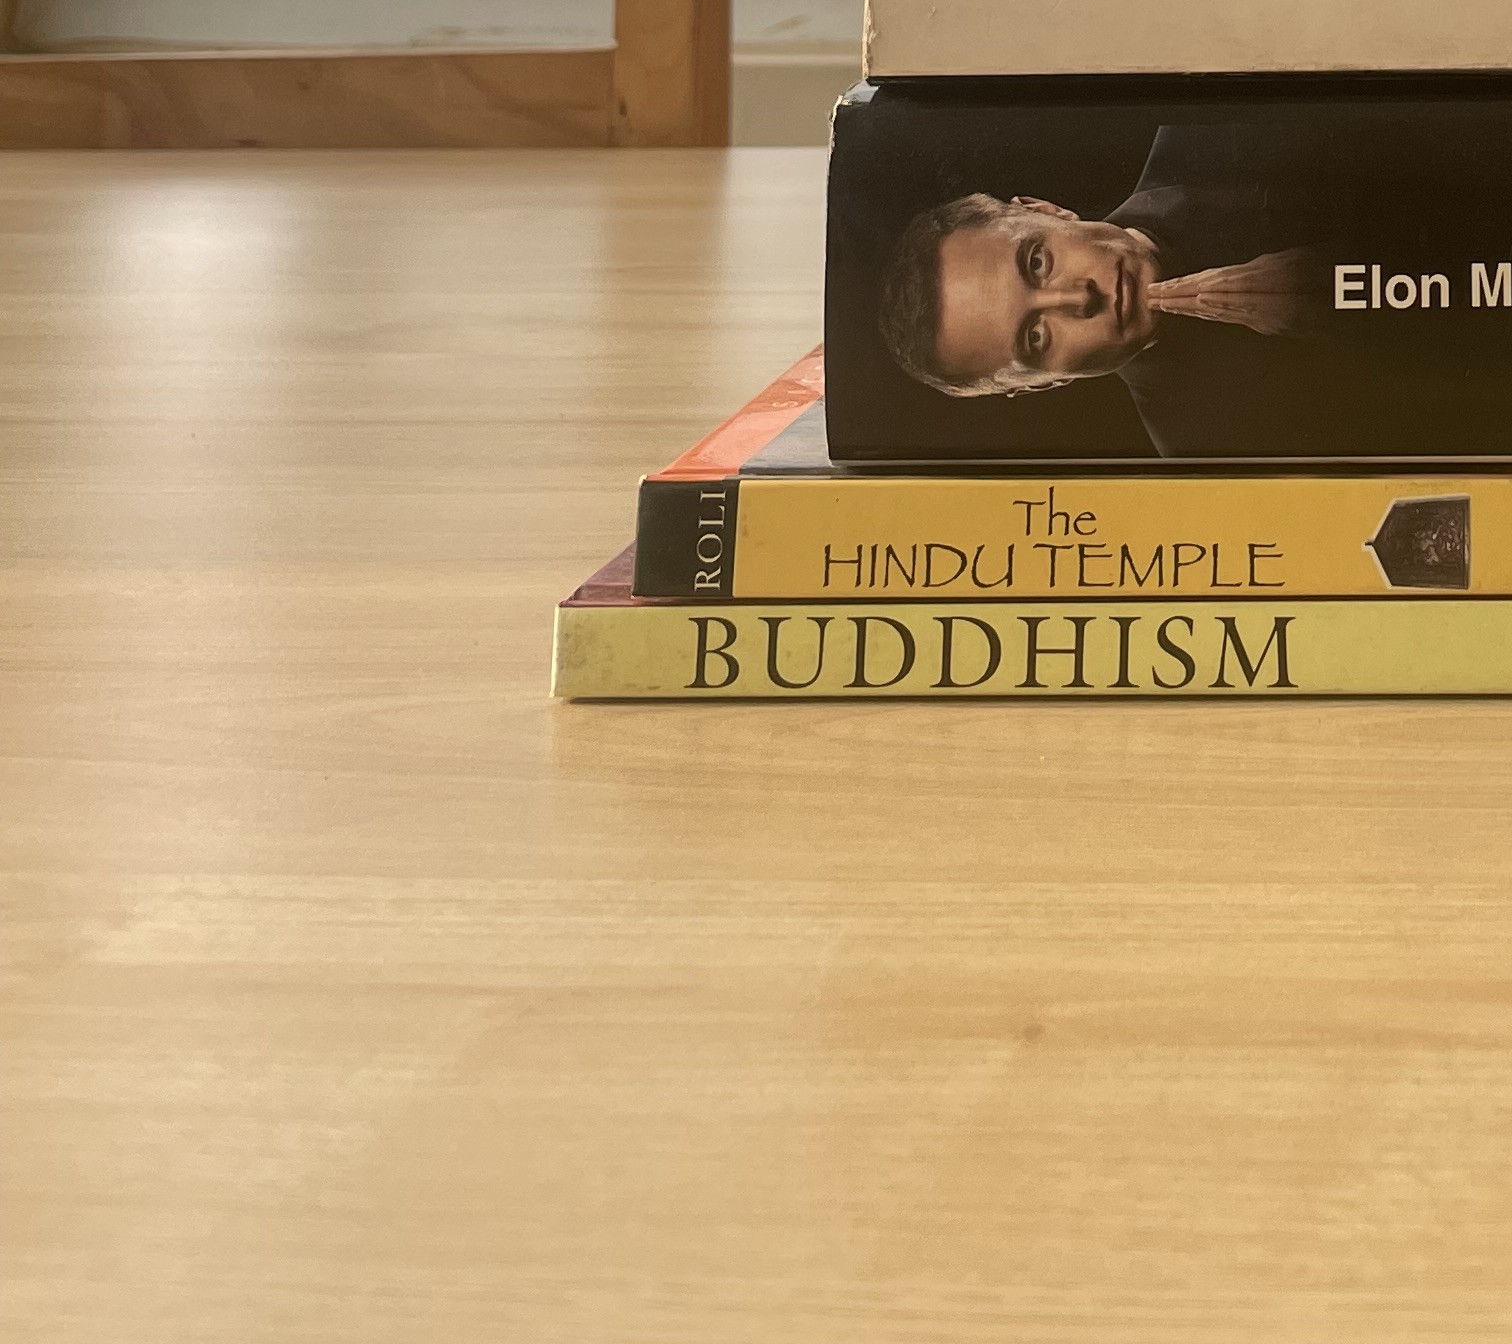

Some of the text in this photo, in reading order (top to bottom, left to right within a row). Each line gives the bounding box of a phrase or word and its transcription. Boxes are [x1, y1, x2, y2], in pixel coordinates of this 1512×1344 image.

[1335, 265, 1449, 309] Elon
[1013, 486, 1096, 536] The
[694, 490, 727, 592] ROLI
[823, 543, 1285, 588] HINDU TEMPLE
[684, 616, 1298, 689] BUDDHISM
